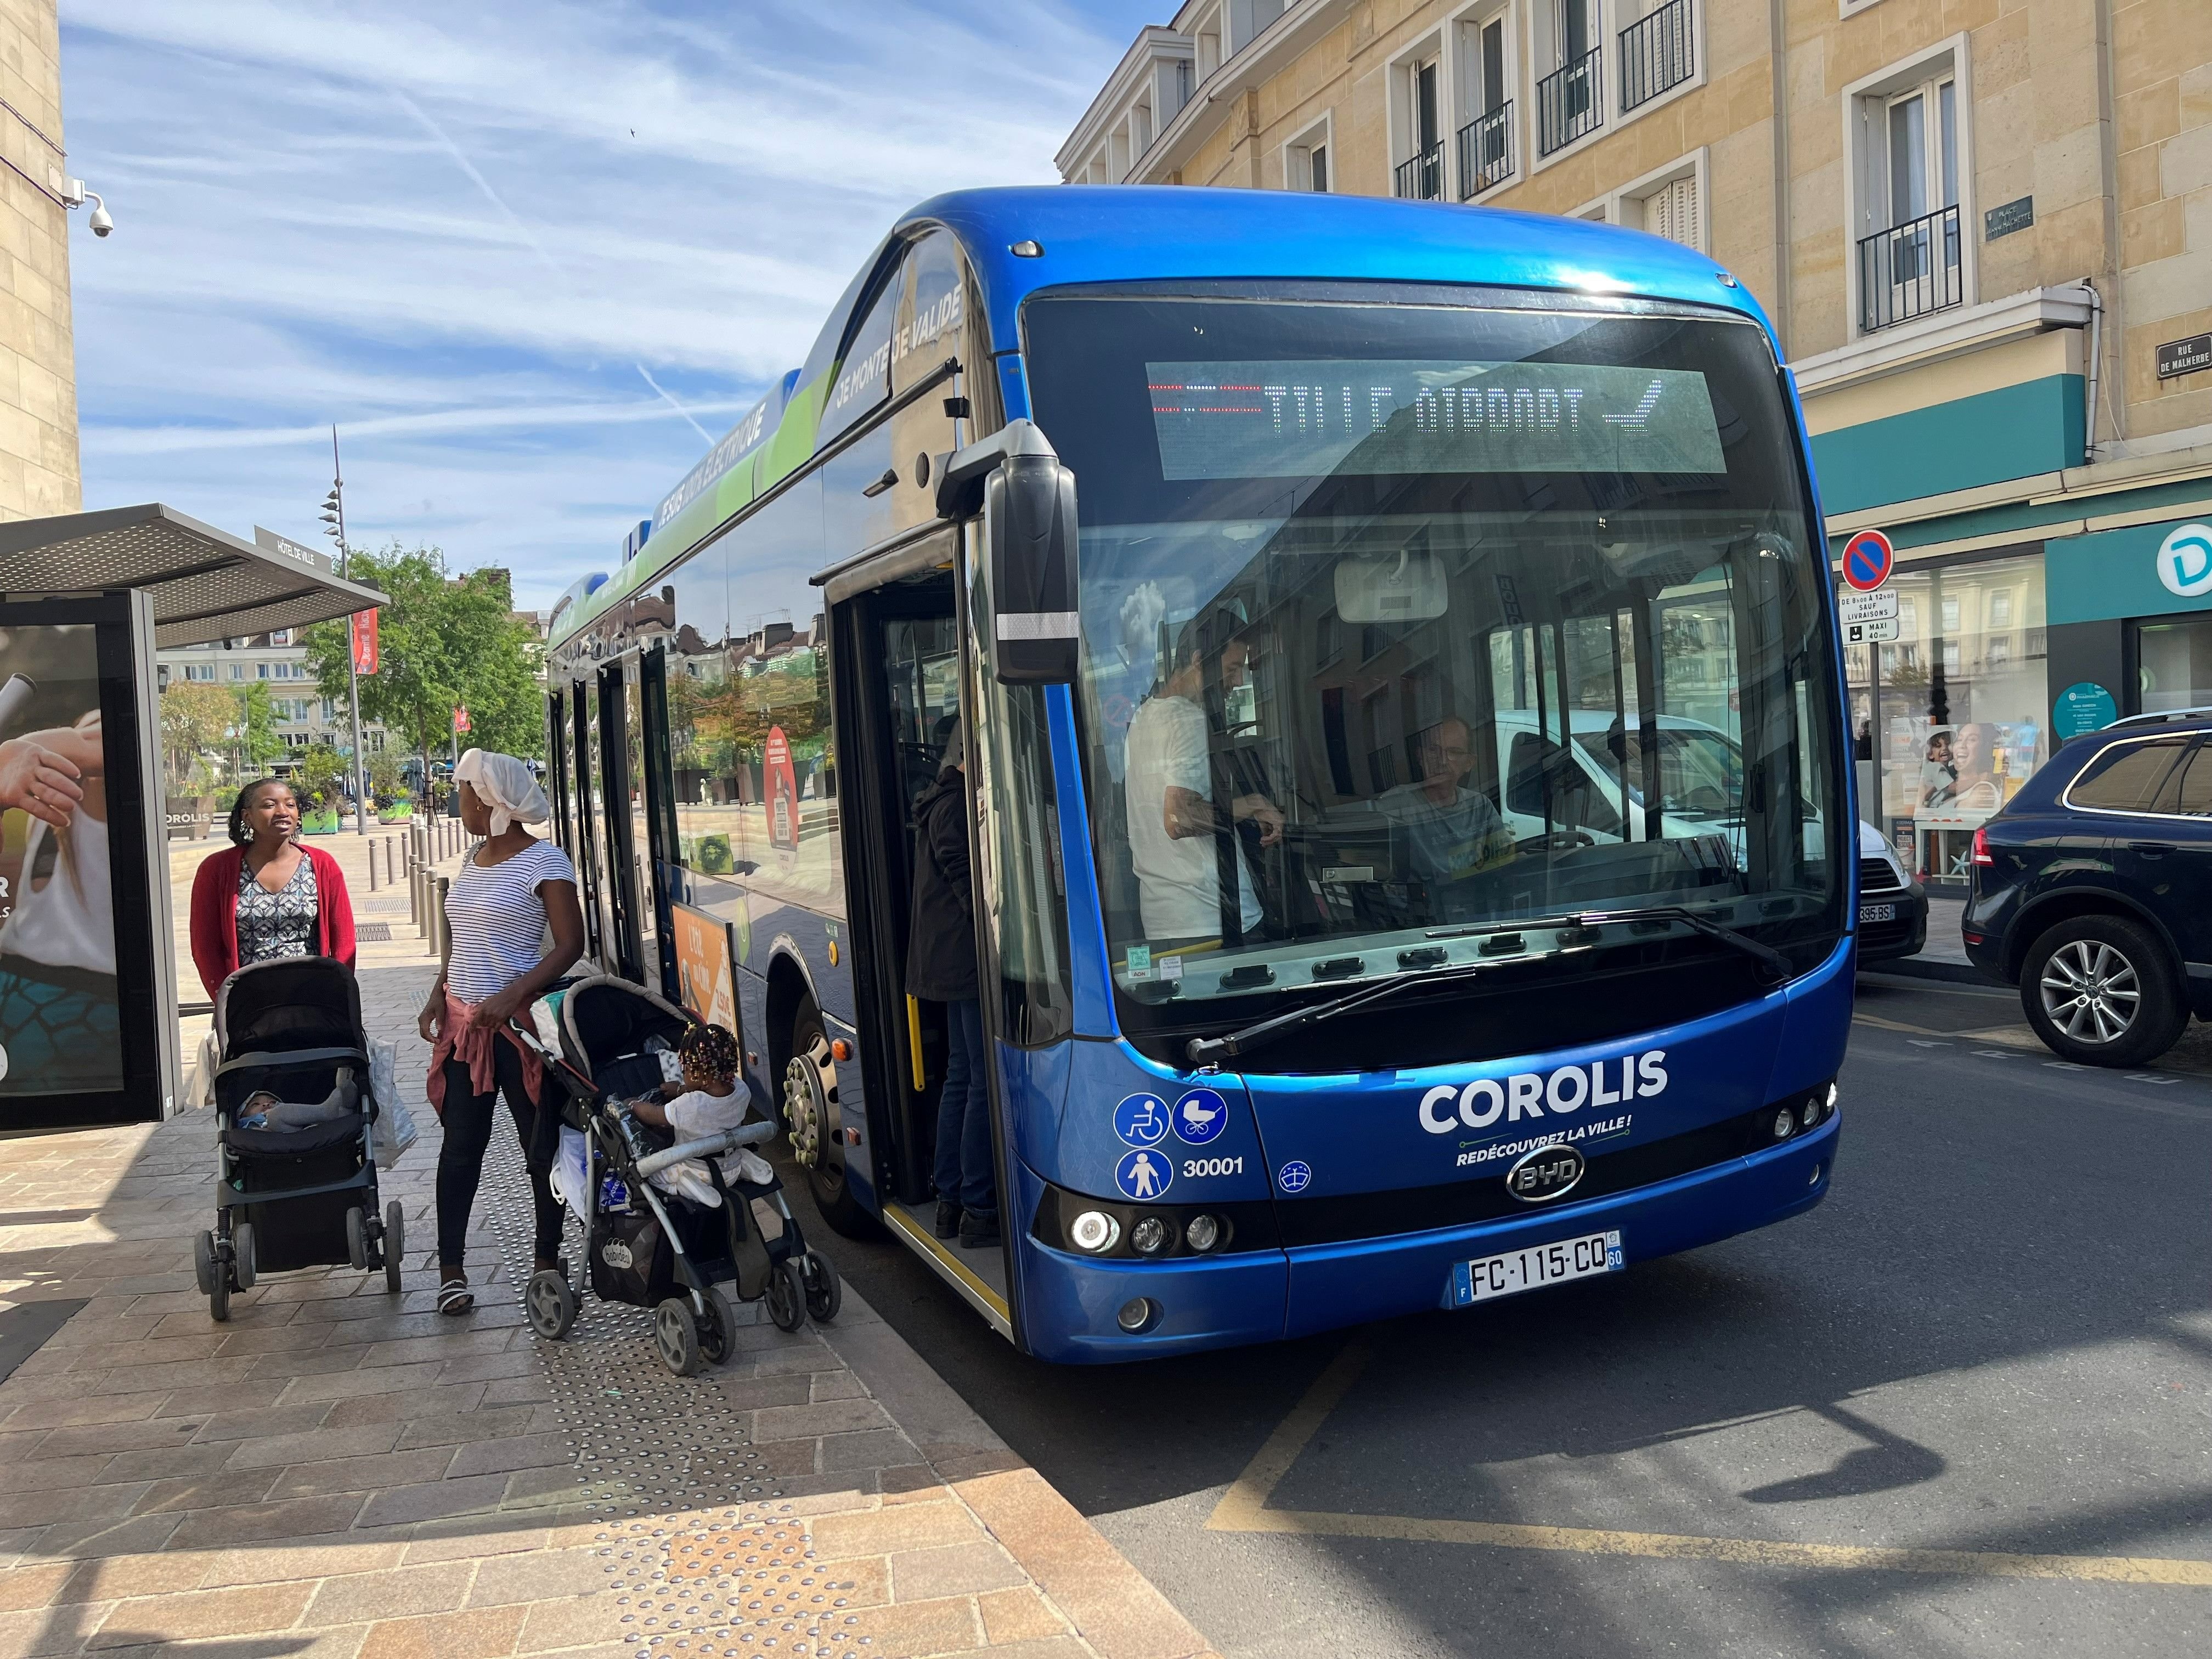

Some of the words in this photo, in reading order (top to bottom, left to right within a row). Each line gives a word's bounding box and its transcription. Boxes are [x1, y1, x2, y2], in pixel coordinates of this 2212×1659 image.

[1999, 206, 2017, 217] PLACE
[2003, 212, 2031, 227] HACHETTE
[837, 377, 850, 409] JE
[850, 340, 890, 398] MONTE
[892, 326, 910, 364] JE
[912, 283, 962, 351] VALIDE
[2178, 344, 2192, 356] RUE
[2161, 362, 2170, 373] DE
[2172, 352, 2210, 369] MALHERBE
[277, 539, 295, 558] HÔTEL
[294, 547, 301, 560] DE
[301, 550, 315, 566] VILLE
[1848, 609, 1888, 620] LIVRAISONS
[1869, 622, 1887, 630] MAXI
[1419, 1050, 1668, 1134] COROLIS
[1457, 1131, 1565, 1167] REDÉCOUVREZ
[1567, 1127, 1585, 1141] LA
[1183, 1156, 1243, 1177] 30001
[1517, 1159, 1577, 1190] BYD
[1460, 1288, 1466, 1297] F
[1607, 1250, 1622, 1266] 60
